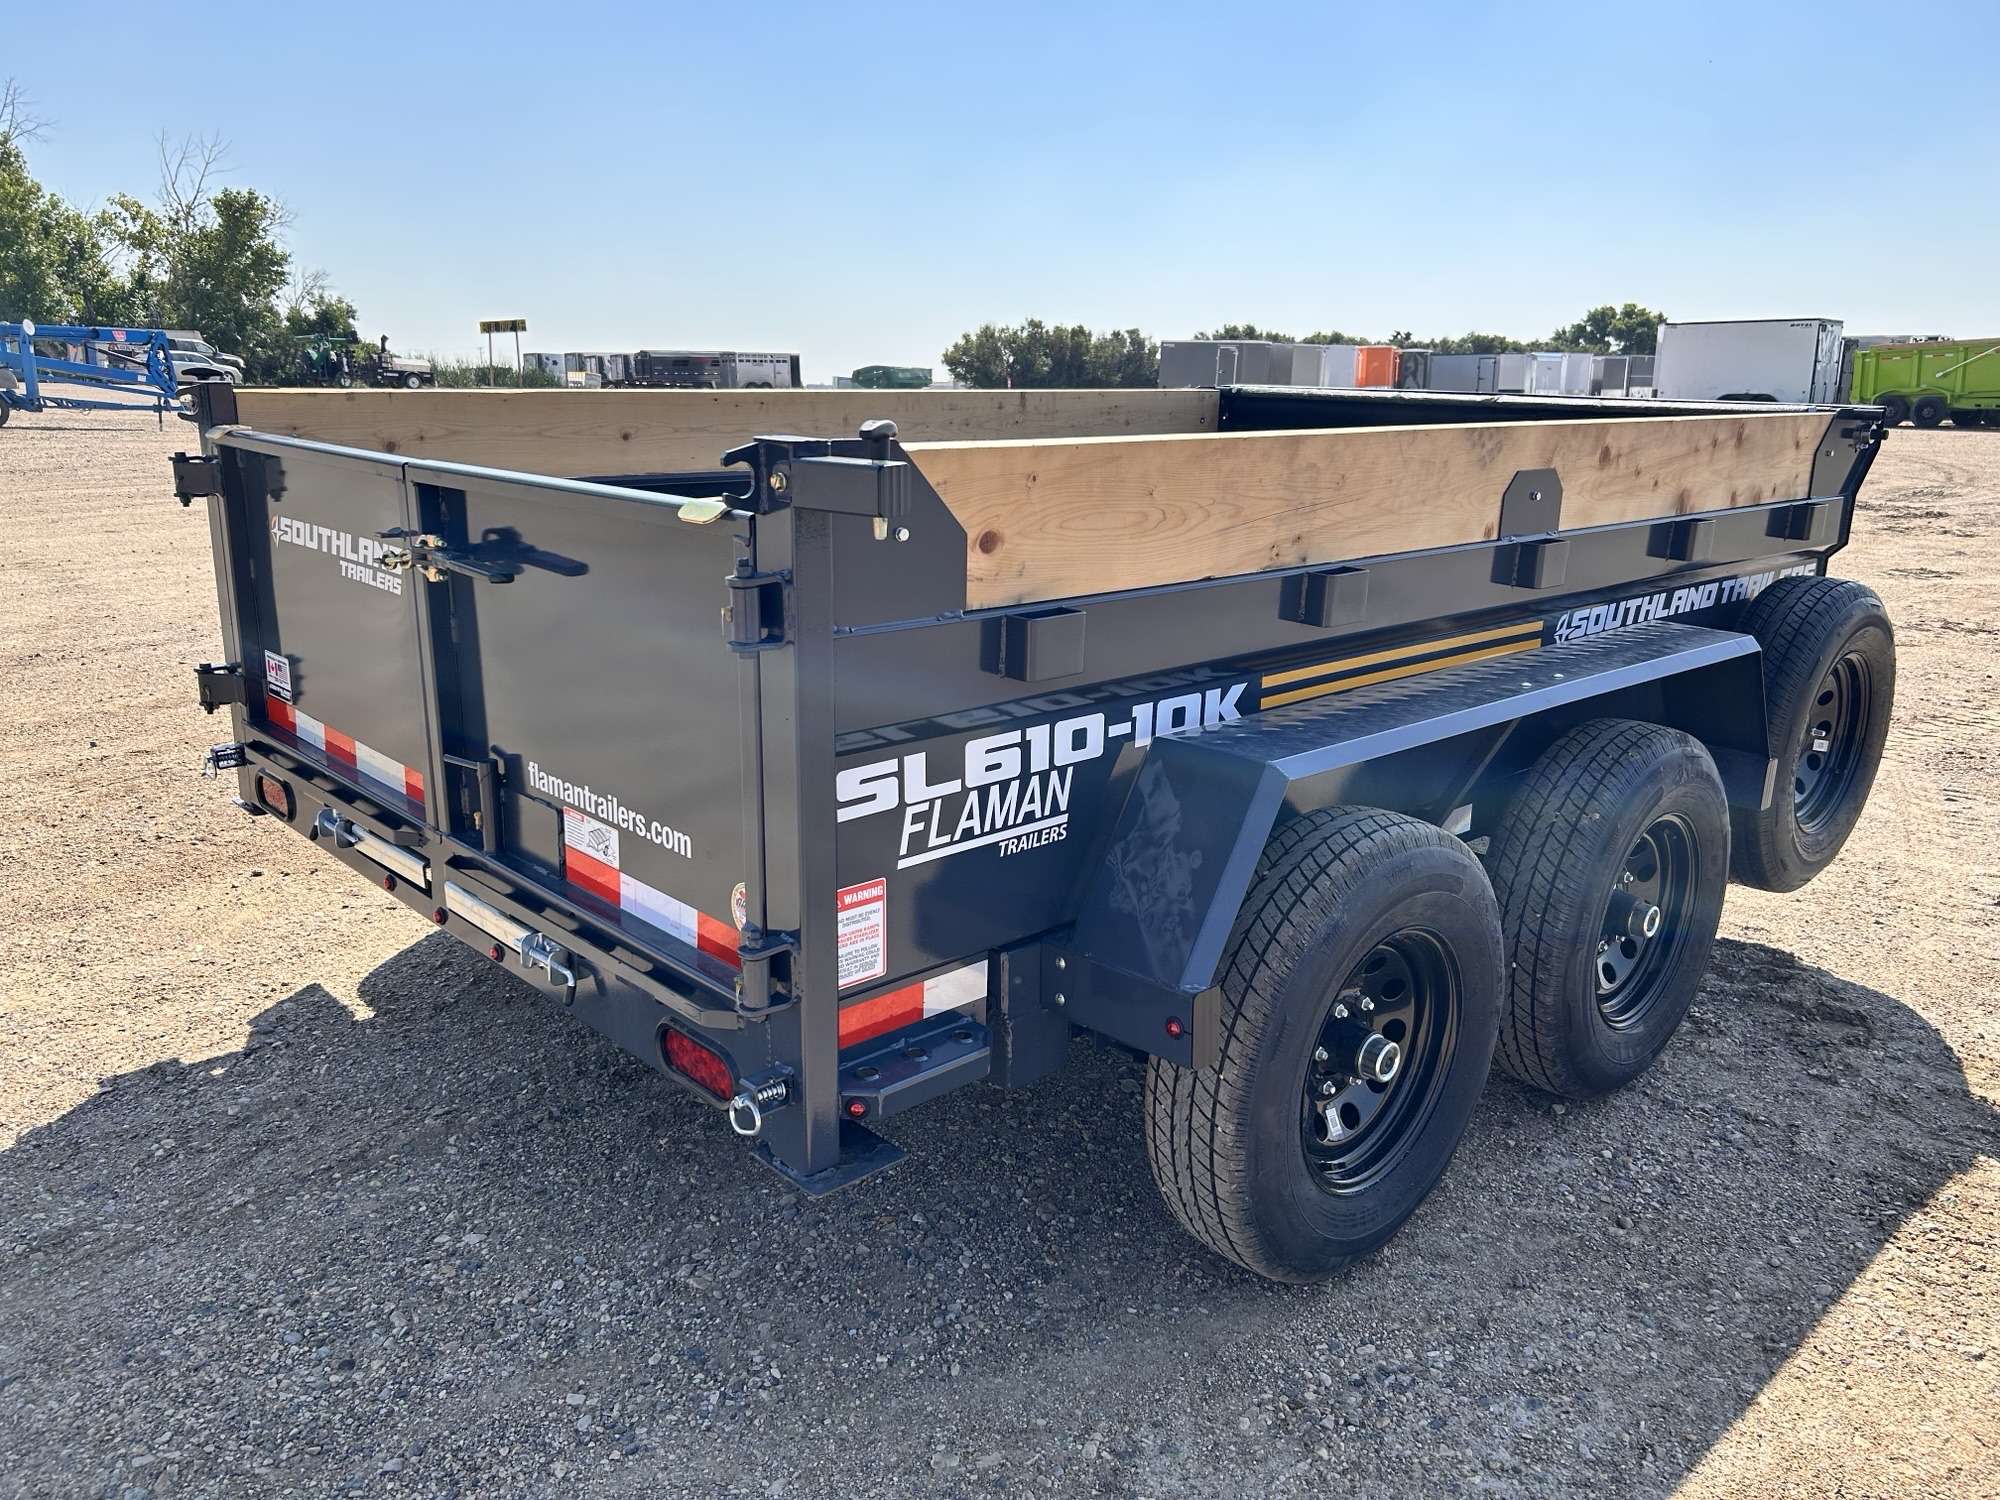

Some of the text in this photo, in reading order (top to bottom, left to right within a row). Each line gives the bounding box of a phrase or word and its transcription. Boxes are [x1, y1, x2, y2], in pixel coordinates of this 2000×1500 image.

[339, 559, 402, 596] TRAILERS
[1571, 583, 1720, 640] SOUTHLAND
[836, 682, 1249, 823] SL610-10K
[528, 761, 693, 859] flamantrailers.com
[899, 766, 1074, 855] FLAMAN
[998, 823, 1068, 857] TRAILERS
[843, 886, 883, 905] WARNING
